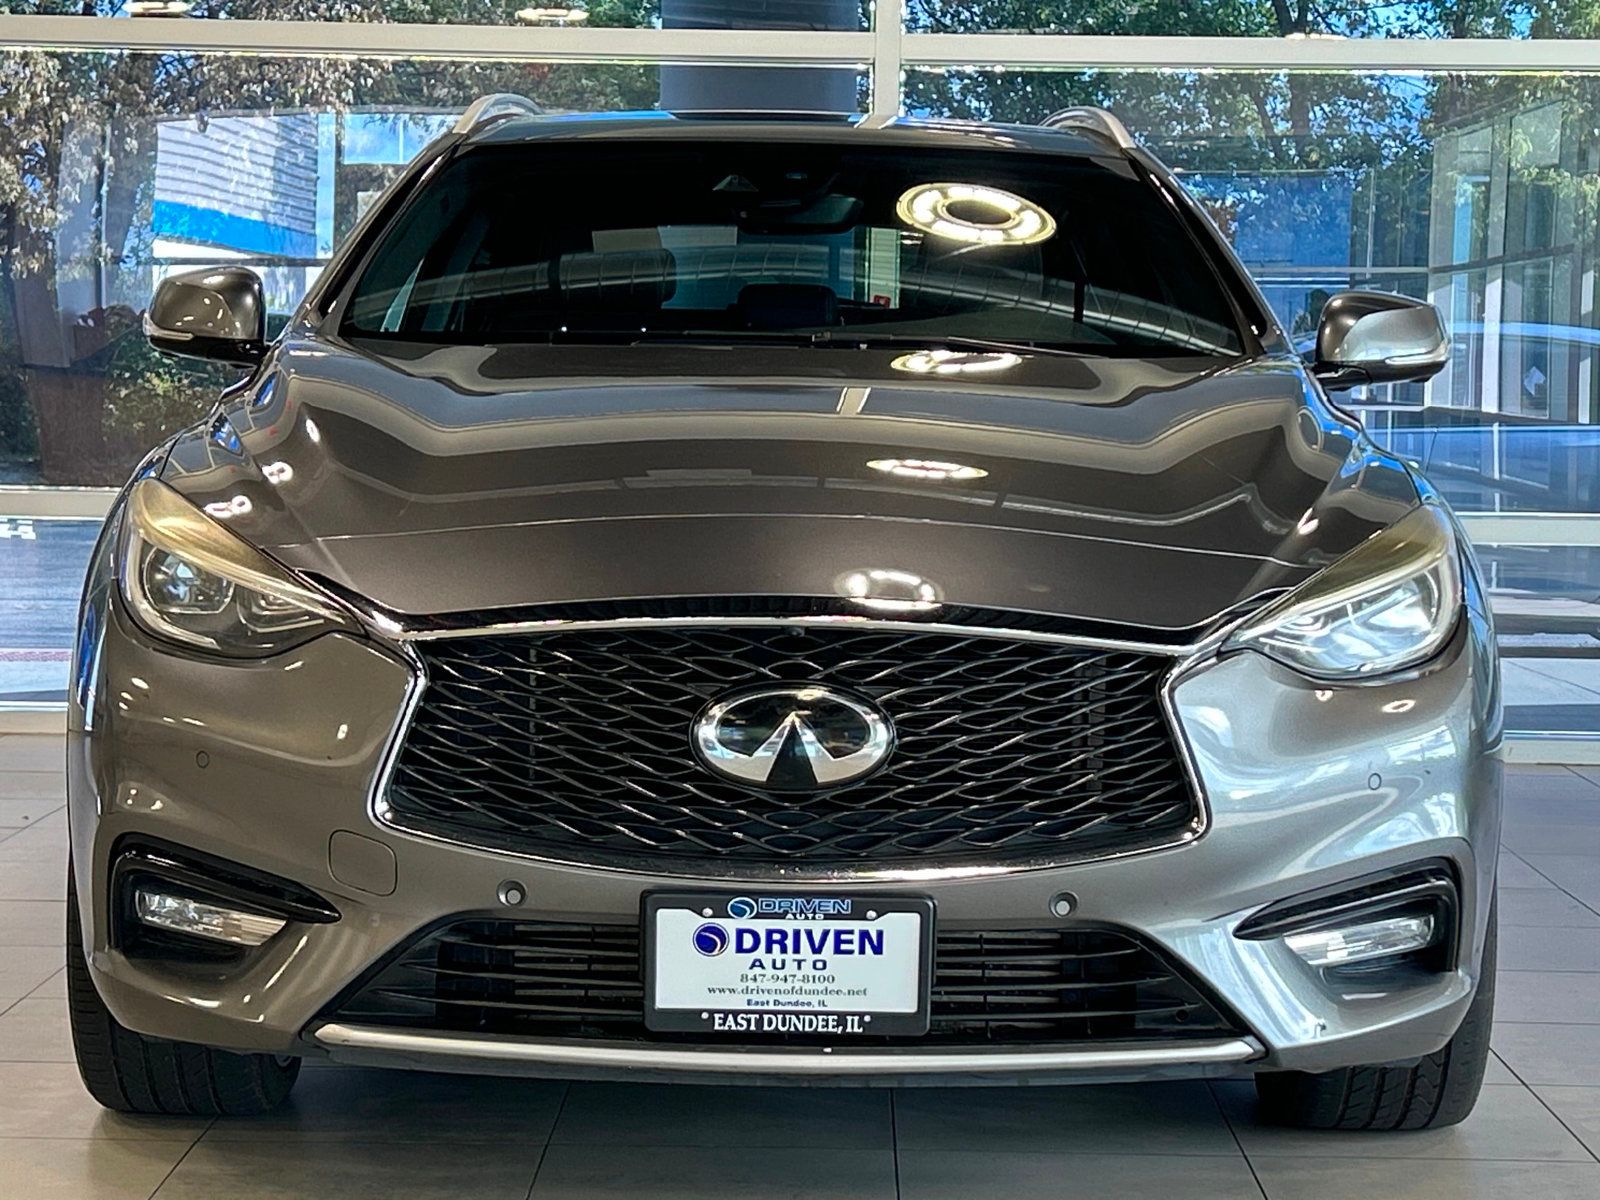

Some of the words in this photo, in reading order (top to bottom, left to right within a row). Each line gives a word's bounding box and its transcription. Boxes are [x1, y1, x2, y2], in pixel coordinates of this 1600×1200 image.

[759, 898, 851, 914] DRIVEN
[734, 928, 884, 955] DRIVEN
[749, 959, 828, 971] AUTO
[740, 973, 835, 984] 847-947-8100
[707, 985, 868, 997] www.drivenofdundee.net
[746, 999, 770, 1007] East
[773, 999, 815, 1008] Dundee,
[818, 1000, 828, 1008] IL
[713, 1013, 759, 1031] EAST
[762, 1014, 843, 1034] DUNDEE,
[846, 1016, 863, 1032] IL
